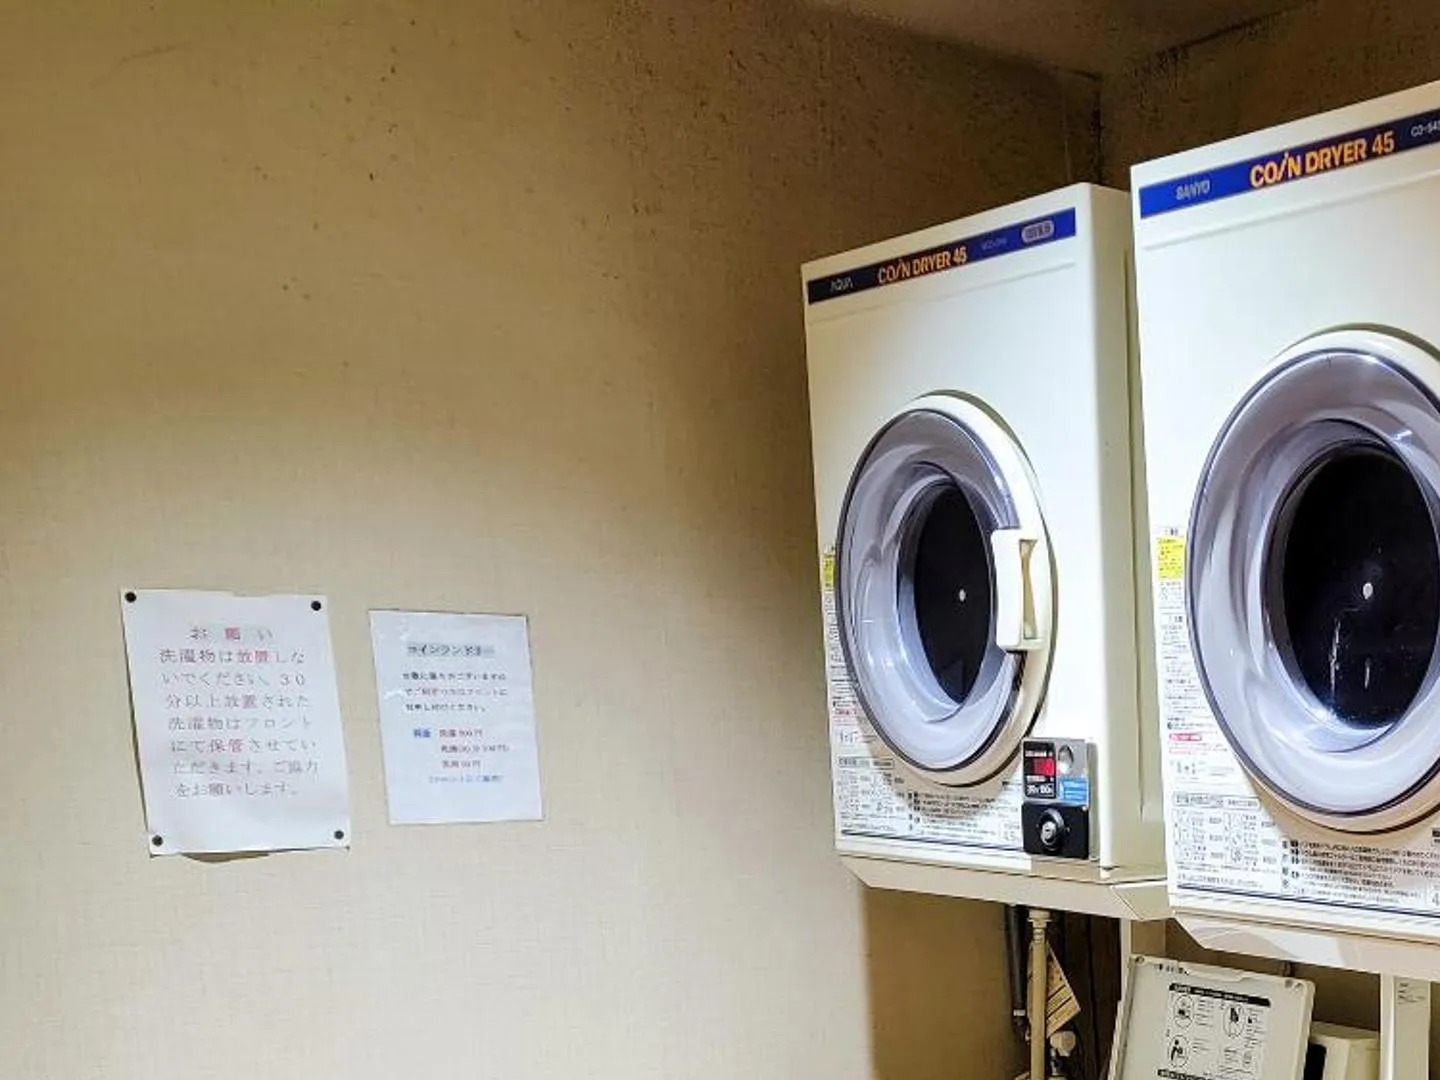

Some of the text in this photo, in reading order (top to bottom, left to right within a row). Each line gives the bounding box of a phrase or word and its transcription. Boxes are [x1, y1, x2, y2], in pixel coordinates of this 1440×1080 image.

[1304, 138, 1367, 173] DRYER
[1372, 130, 1395, 155] 45
[913, 250, 951, 274] DRYER
[953, 245, 967, 264] 45
